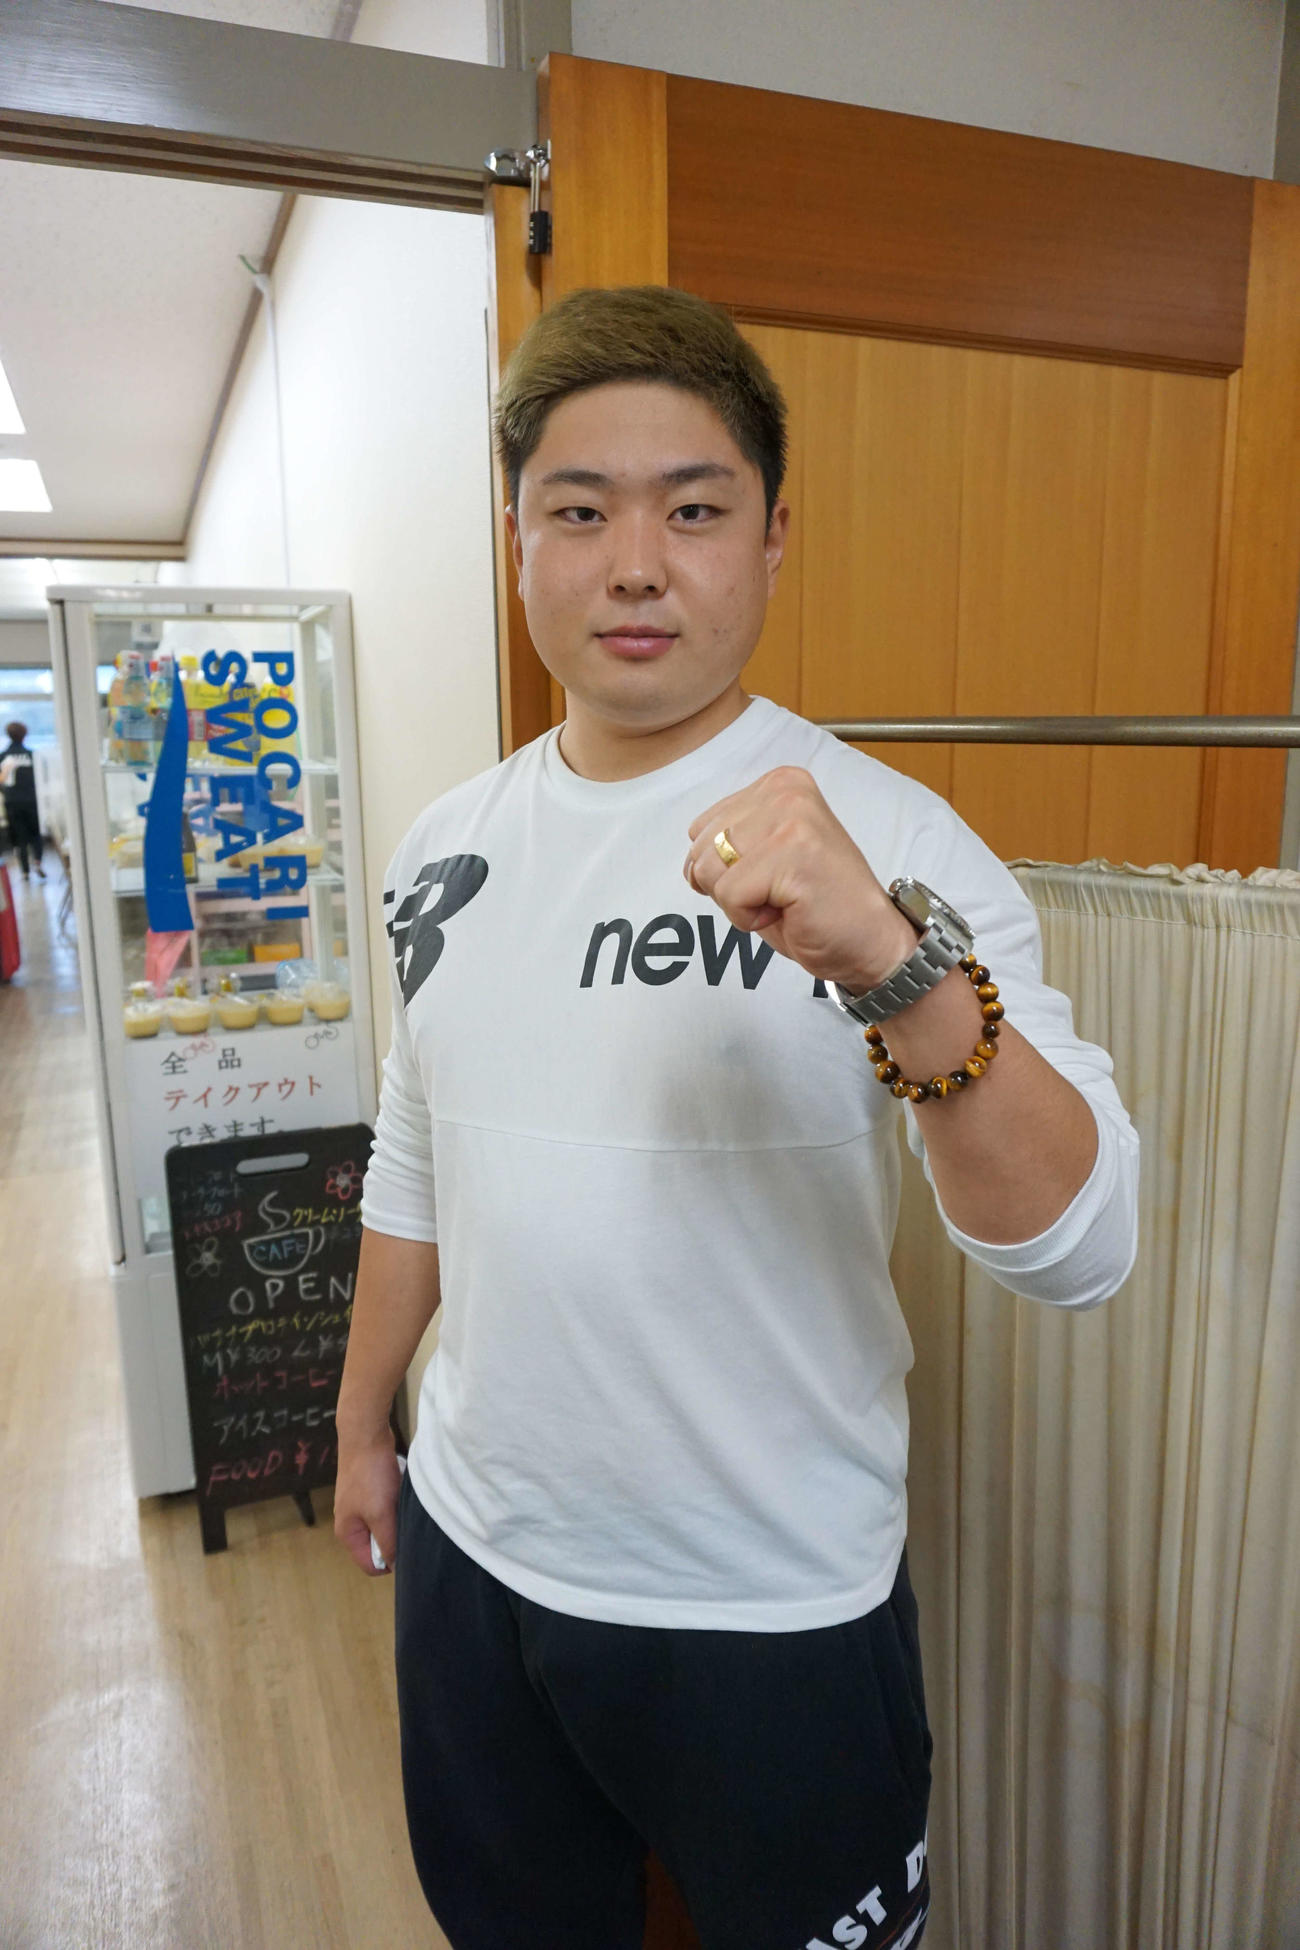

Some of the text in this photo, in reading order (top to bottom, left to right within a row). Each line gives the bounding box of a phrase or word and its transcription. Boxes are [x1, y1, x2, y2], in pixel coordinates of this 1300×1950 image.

[201, 649, 261, 900] SWEAT
[251, 650, 309, 919] POCARI
[580, 914, 776, 990] new
[163, 1075, 322, 1112] テイクアウト
[168, 1116, 275, 1147] できます
[229, 1272, 353, 1315] OPEN
[206, 1450, 283, 1496] FOOD
